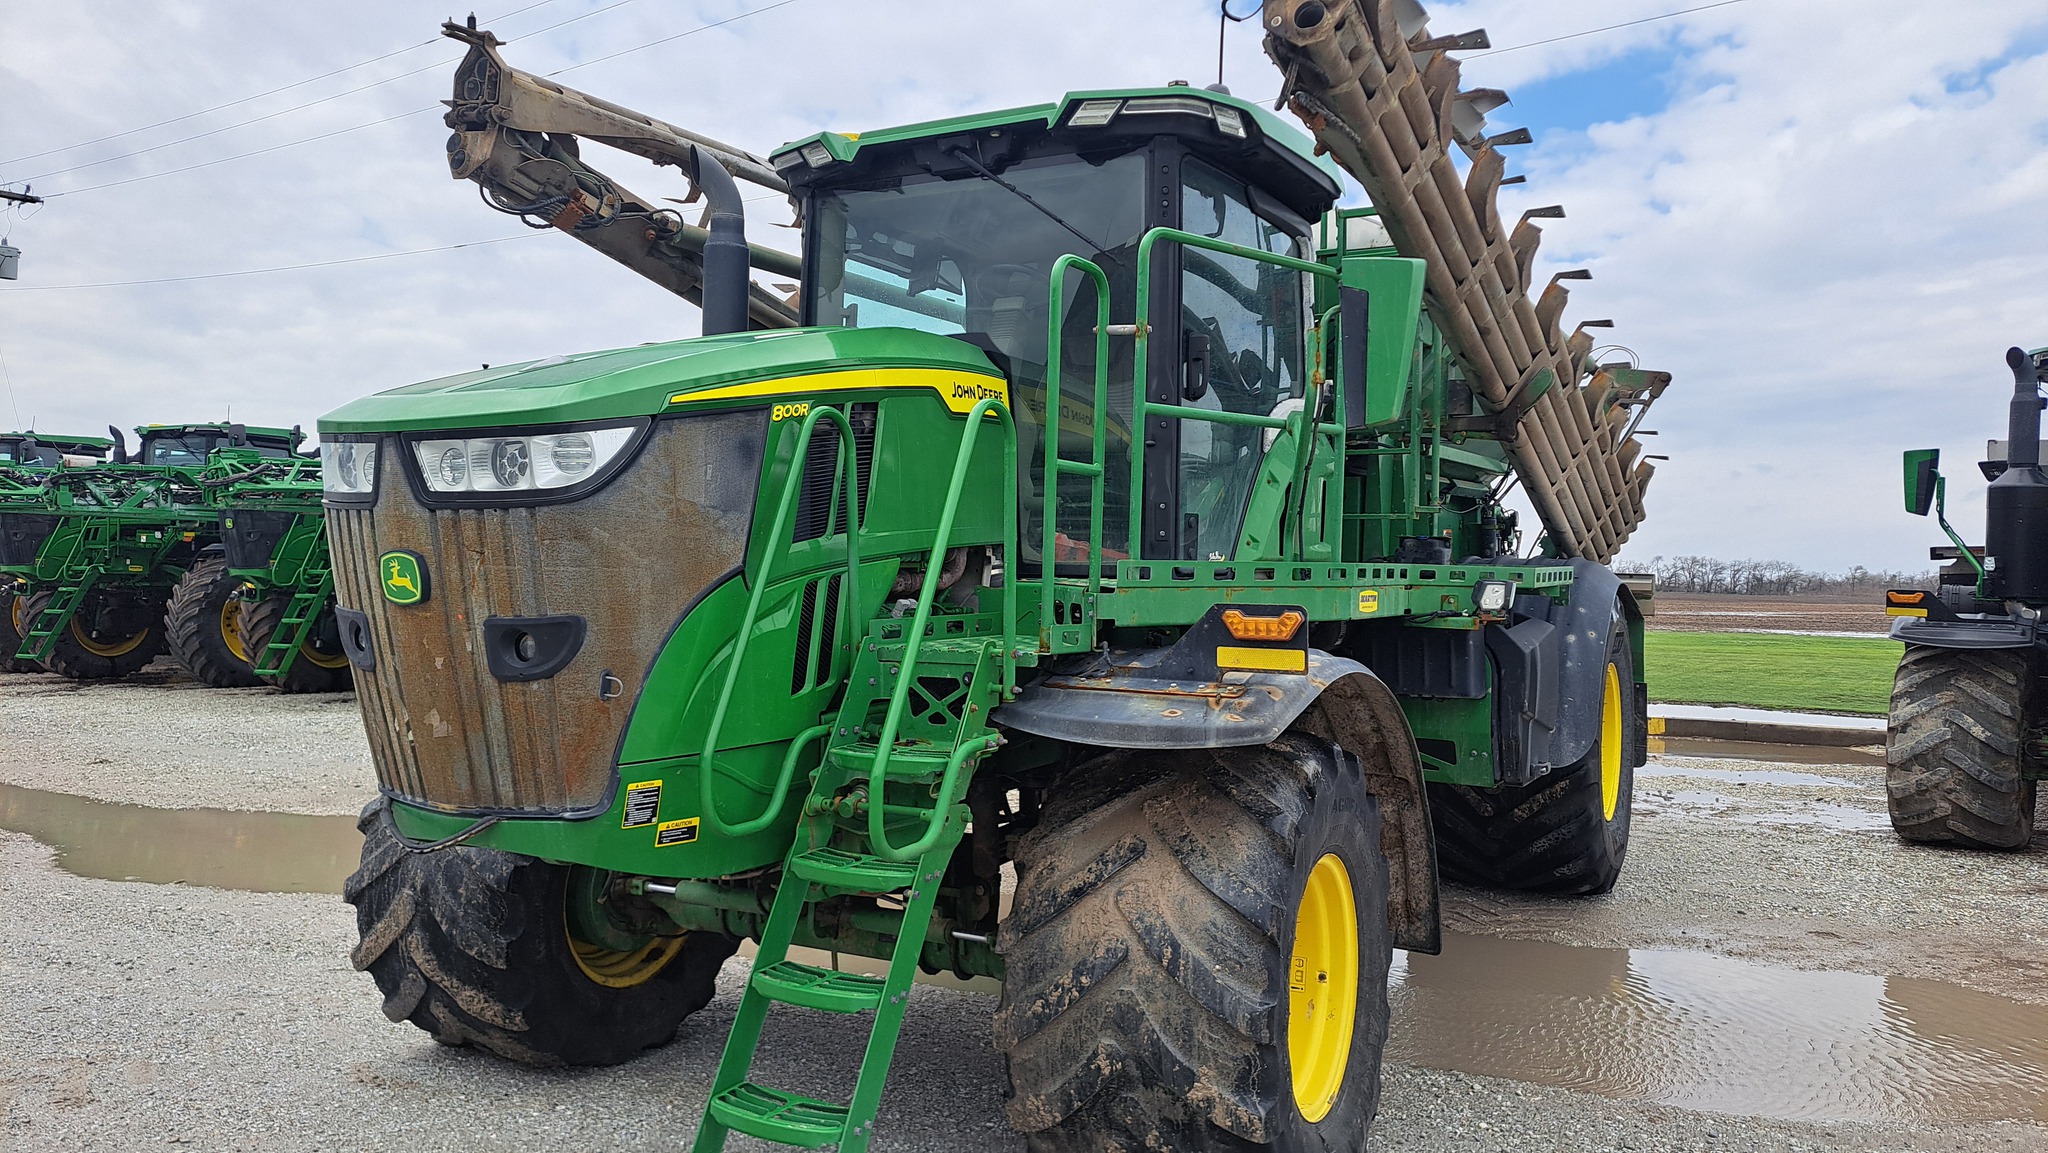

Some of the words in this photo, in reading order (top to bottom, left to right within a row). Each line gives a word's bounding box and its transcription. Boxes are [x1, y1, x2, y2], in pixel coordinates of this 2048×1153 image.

[952, 381, 977, 399] JOHN
[977, 384, 1004, 401] DEERE
[772, 403, 809, 421] 800R
